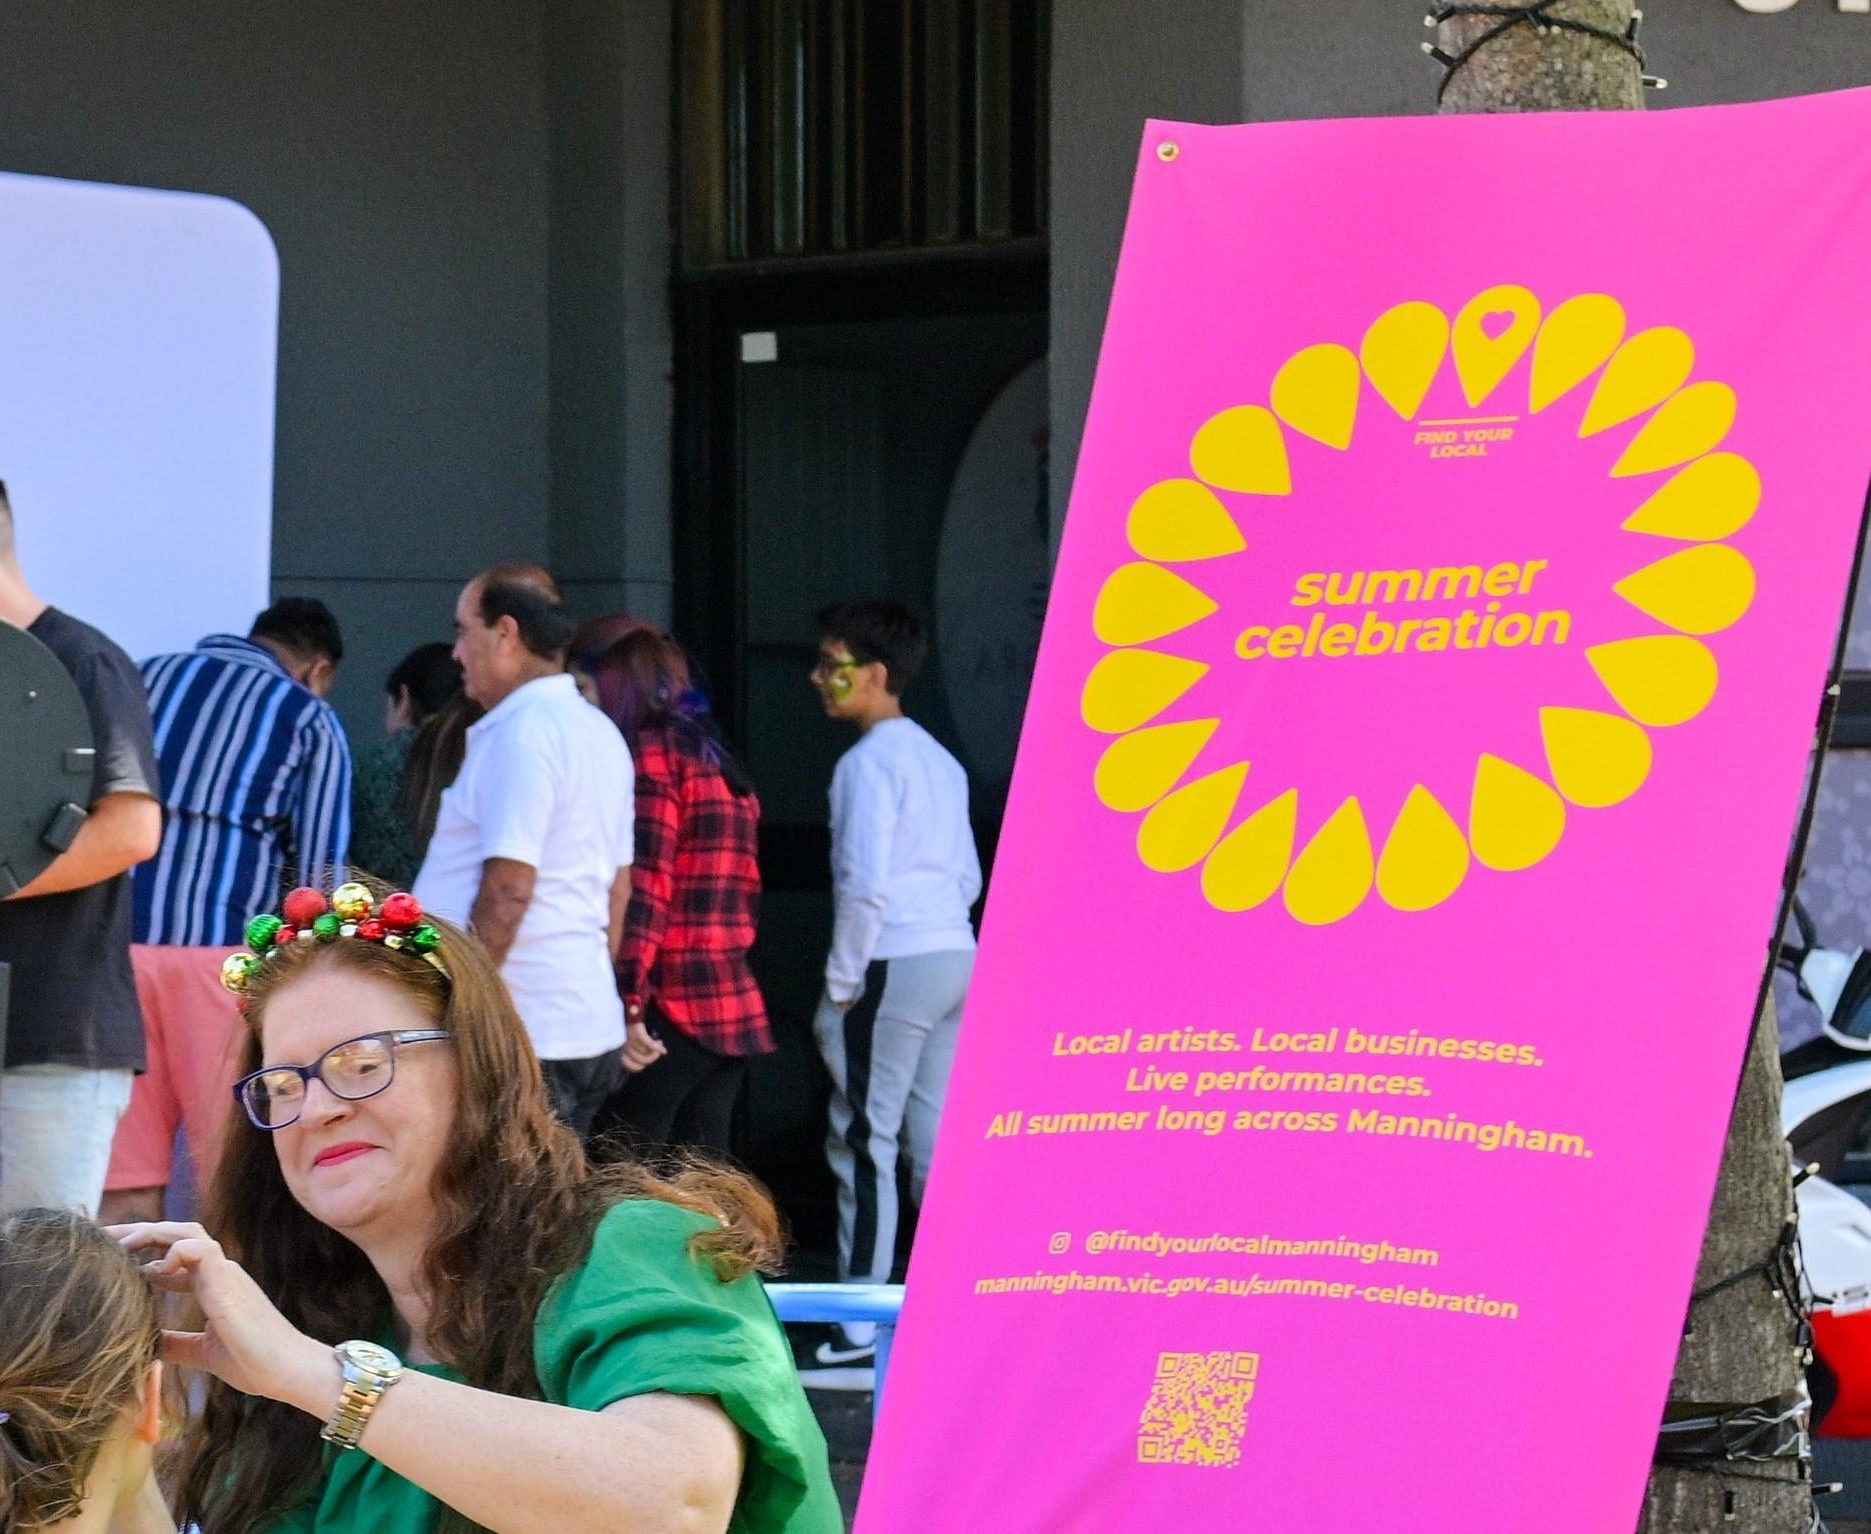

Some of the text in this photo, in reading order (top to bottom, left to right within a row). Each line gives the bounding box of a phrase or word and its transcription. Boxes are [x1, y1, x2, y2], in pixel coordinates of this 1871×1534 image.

[1414, 428, 1514, 444] FIND YOUR
[1430, 444, 1487, 458] LOCAL
[1290, 558, 1549, 607] summer
[1234, 600, 1572, 660] celebration
[1052, 1026, 1545, 1067] Local artists. Local businesses.
[1125, 1064, 1433, 1097] Live performances.
[984, 1105, 1595, 1159] All summer long across Manningham.
[1085, 1229, 1441, 1266] @findyourlocalmanningham
[974, 1270, 1520, 1320] manningham.vic.gov.au/summer-celebration
